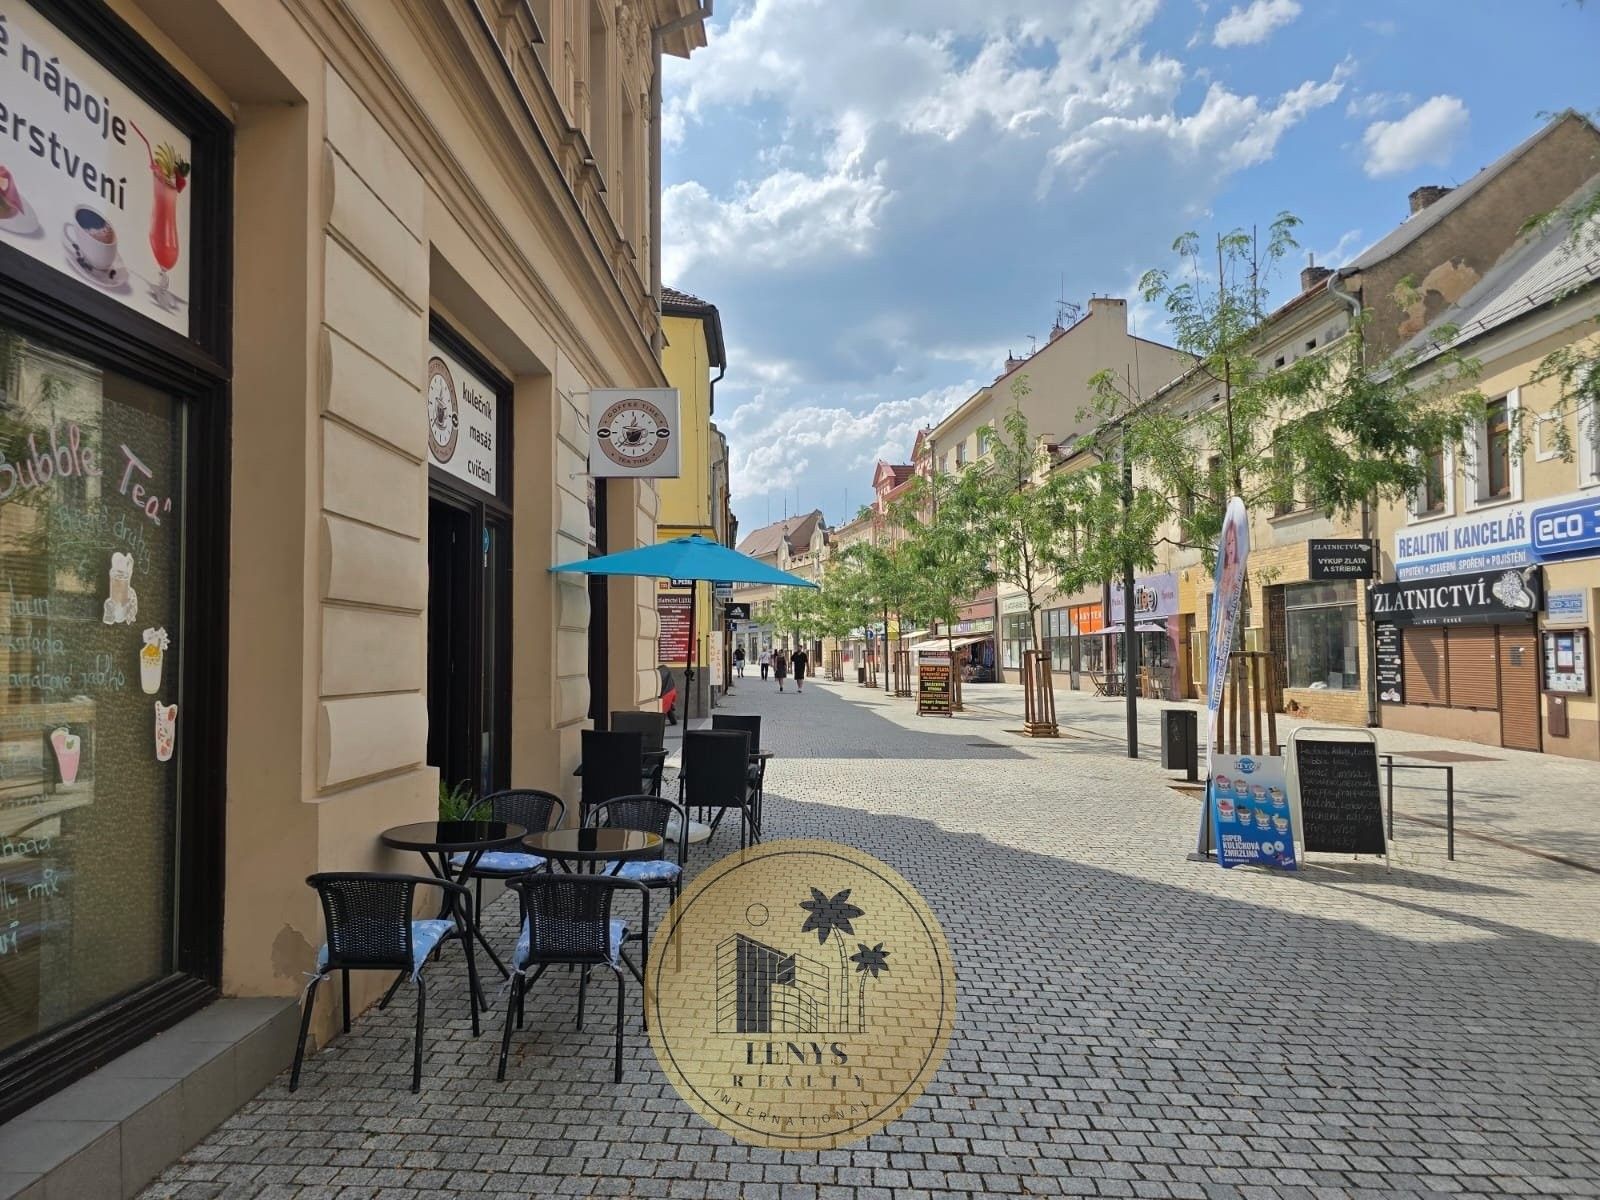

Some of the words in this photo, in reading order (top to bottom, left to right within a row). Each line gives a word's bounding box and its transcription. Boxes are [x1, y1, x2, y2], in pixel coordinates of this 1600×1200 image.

[21, 41, 128, 146] nápoje
[462, 381, 492, 421] kulečník
[469, 425, 492, 451] masáž
[466, 459, 491, 484] cvičení
[1398, 526, 1449, 558] REALITNÍ
[1453, 508, 1526, 550] KANCELÁŘ
[1221, 834, 1242, 842] SUPER
